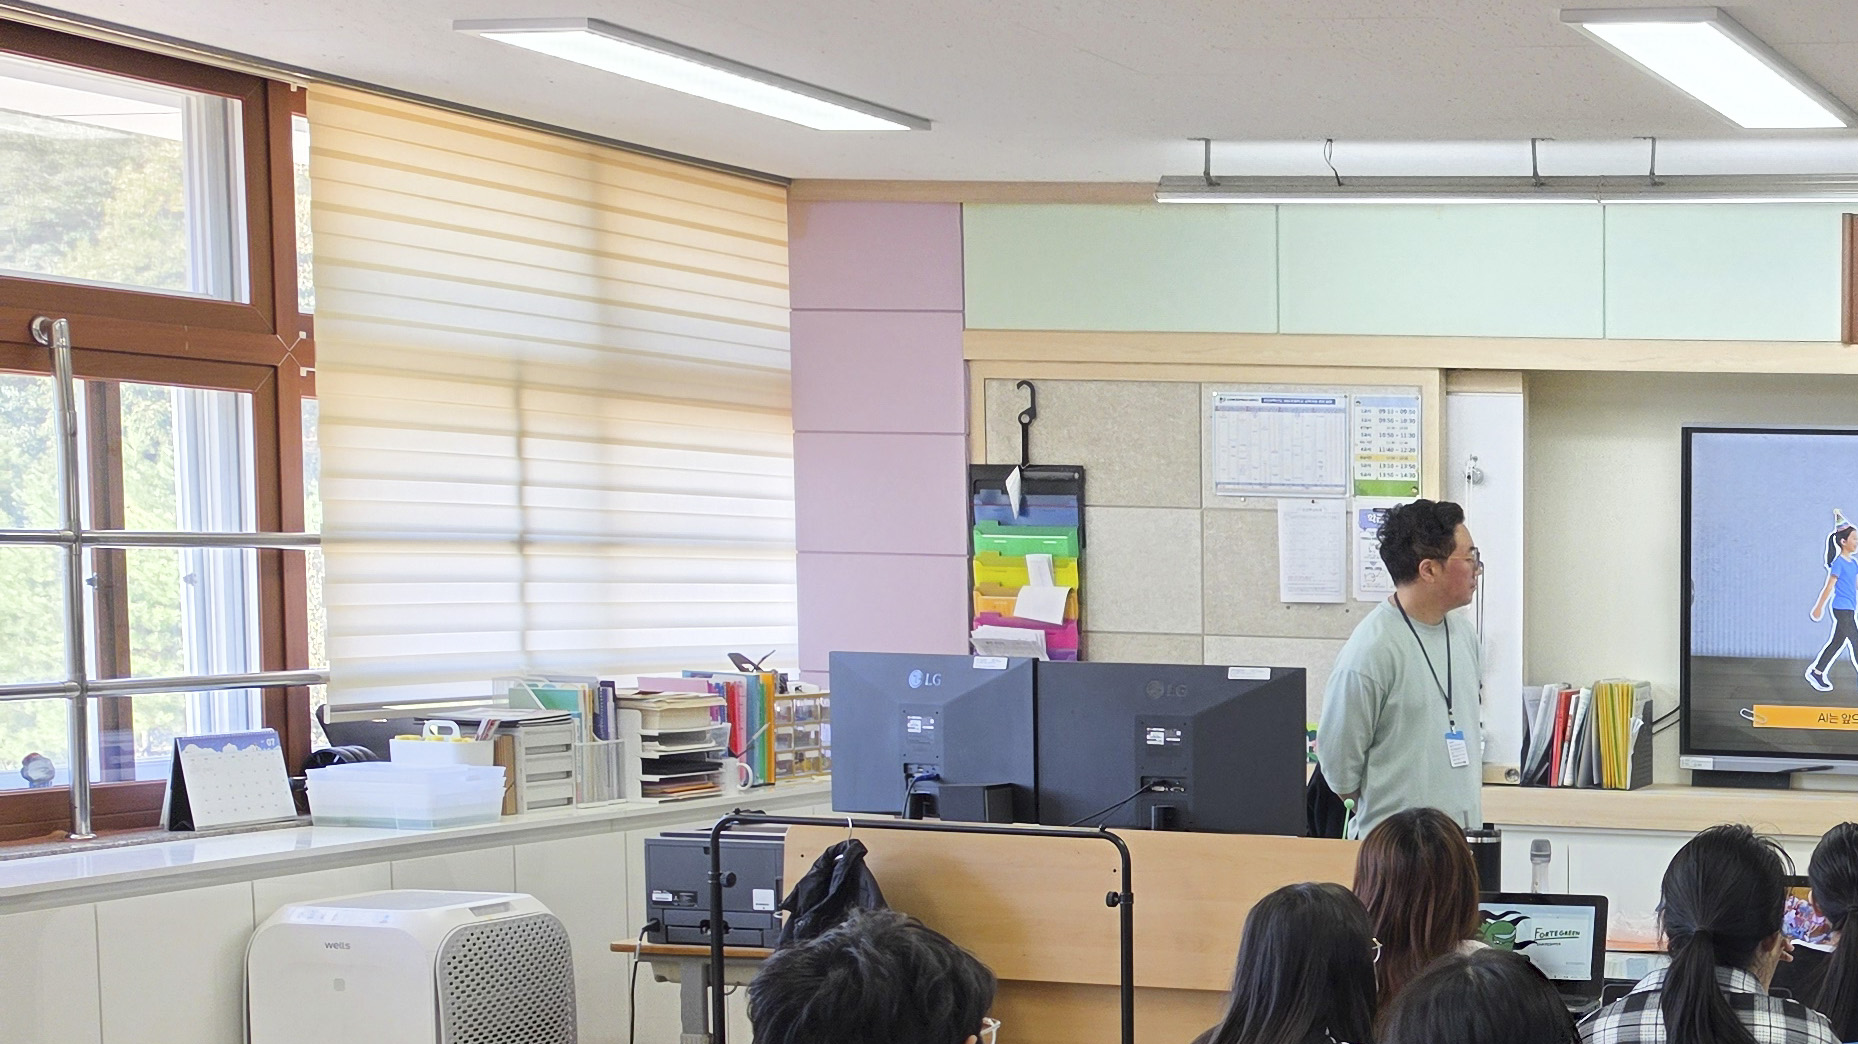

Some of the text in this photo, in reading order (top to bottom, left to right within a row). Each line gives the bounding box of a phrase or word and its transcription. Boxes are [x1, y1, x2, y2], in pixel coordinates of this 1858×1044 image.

[924, 673, 942, 686] LG
[1166, 683, 1187, 697] LG
[1818, 713, 1839, 724] AI는
[325, 941, 351, 950] wells
